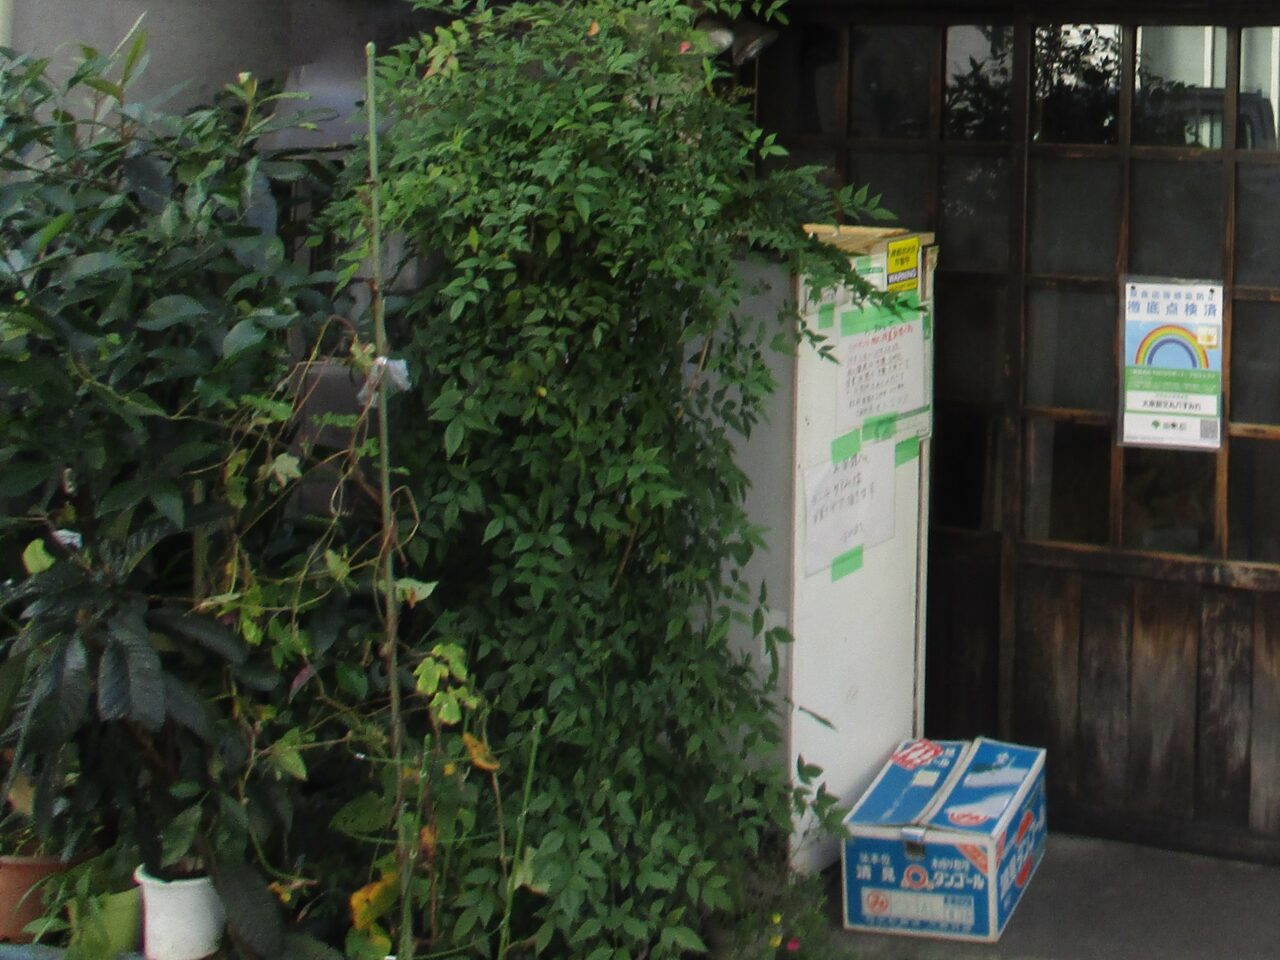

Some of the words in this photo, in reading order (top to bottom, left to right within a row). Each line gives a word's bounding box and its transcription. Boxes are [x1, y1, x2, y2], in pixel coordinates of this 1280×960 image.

[1128, 300, 1217, 318] 徹底点検済
[932, 871, 985, 891] タンゴール
